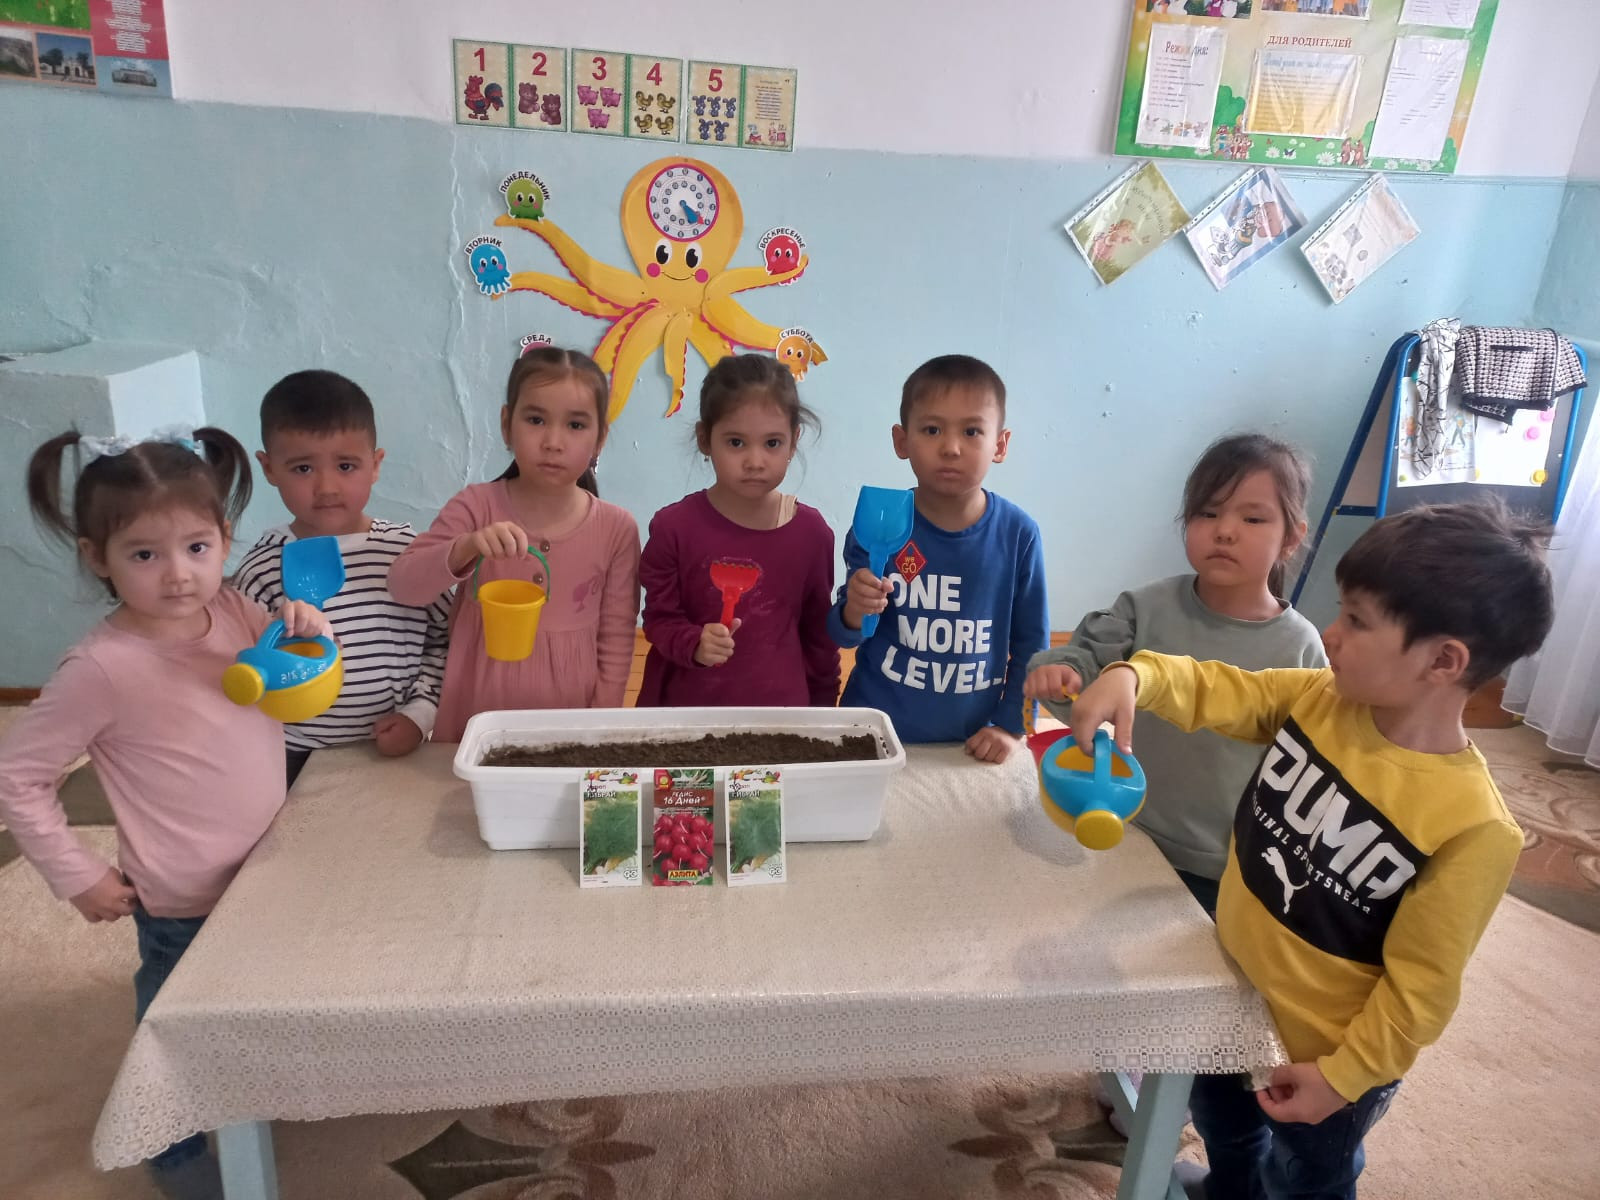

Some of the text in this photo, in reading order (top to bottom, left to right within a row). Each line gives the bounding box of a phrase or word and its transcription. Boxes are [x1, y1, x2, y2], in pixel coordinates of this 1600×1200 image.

[1267, 35, 1352, 48] ДЛЯ РОДИТЕЛЕЙ
[473, 47, 486, 72] 1
[531, 51, 548, 76] 2
[591, 56, 607, 80] 3
[646, 62, 663, 86] 4
[708, 68, 724, 92] 5
[500, 171, 551, 201] ПОНЕДЕЛЬНИК
[465, 236, 502, 254] ВТОРНИК
[760, 227, 806, 249] ВОСКРЕСЕНЬЕ
[521, 334, 552, 346] СРЕДА
[781, 329, 813, 344] СУББОТА
[902, 562, 917, 574] GO
[888, 572, 962, 612] ONE
[897, 614, 993, 655] MORE
[663, 796, 673, 805] 16
[1257, 727, 1417, 900] PUMA
[669, 871, 697, 879] АЭЛИТА
[1293, 844, 1371, 914] SPRTSWEAR
